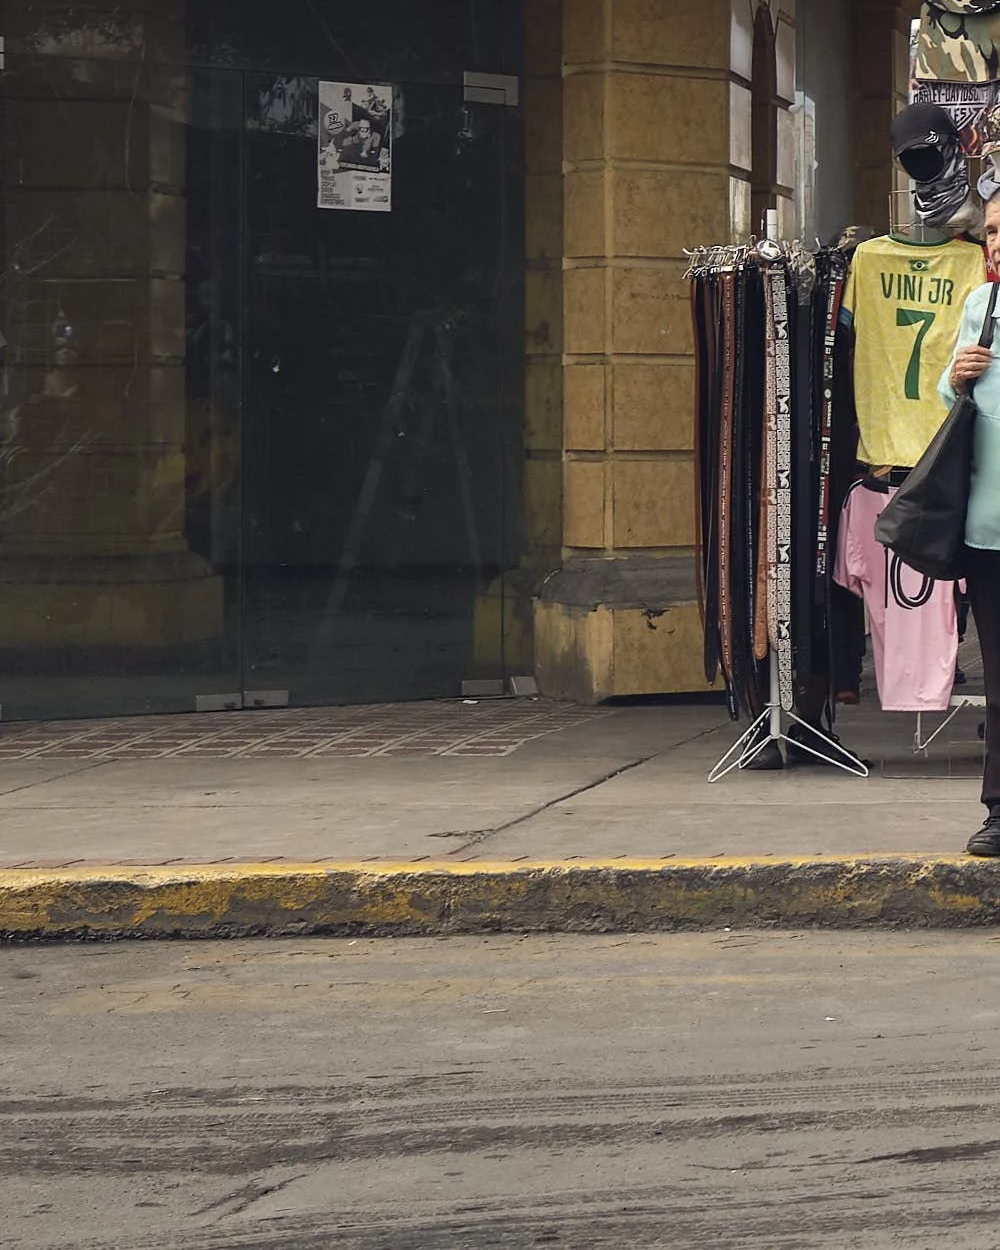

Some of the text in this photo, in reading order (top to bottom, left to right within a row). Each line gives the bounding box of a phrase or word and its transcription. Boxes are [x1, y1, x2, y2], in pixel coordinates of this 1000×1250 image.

[880, 272, 955, 306] VINI JR
[896, 307, 937, 401] 7
